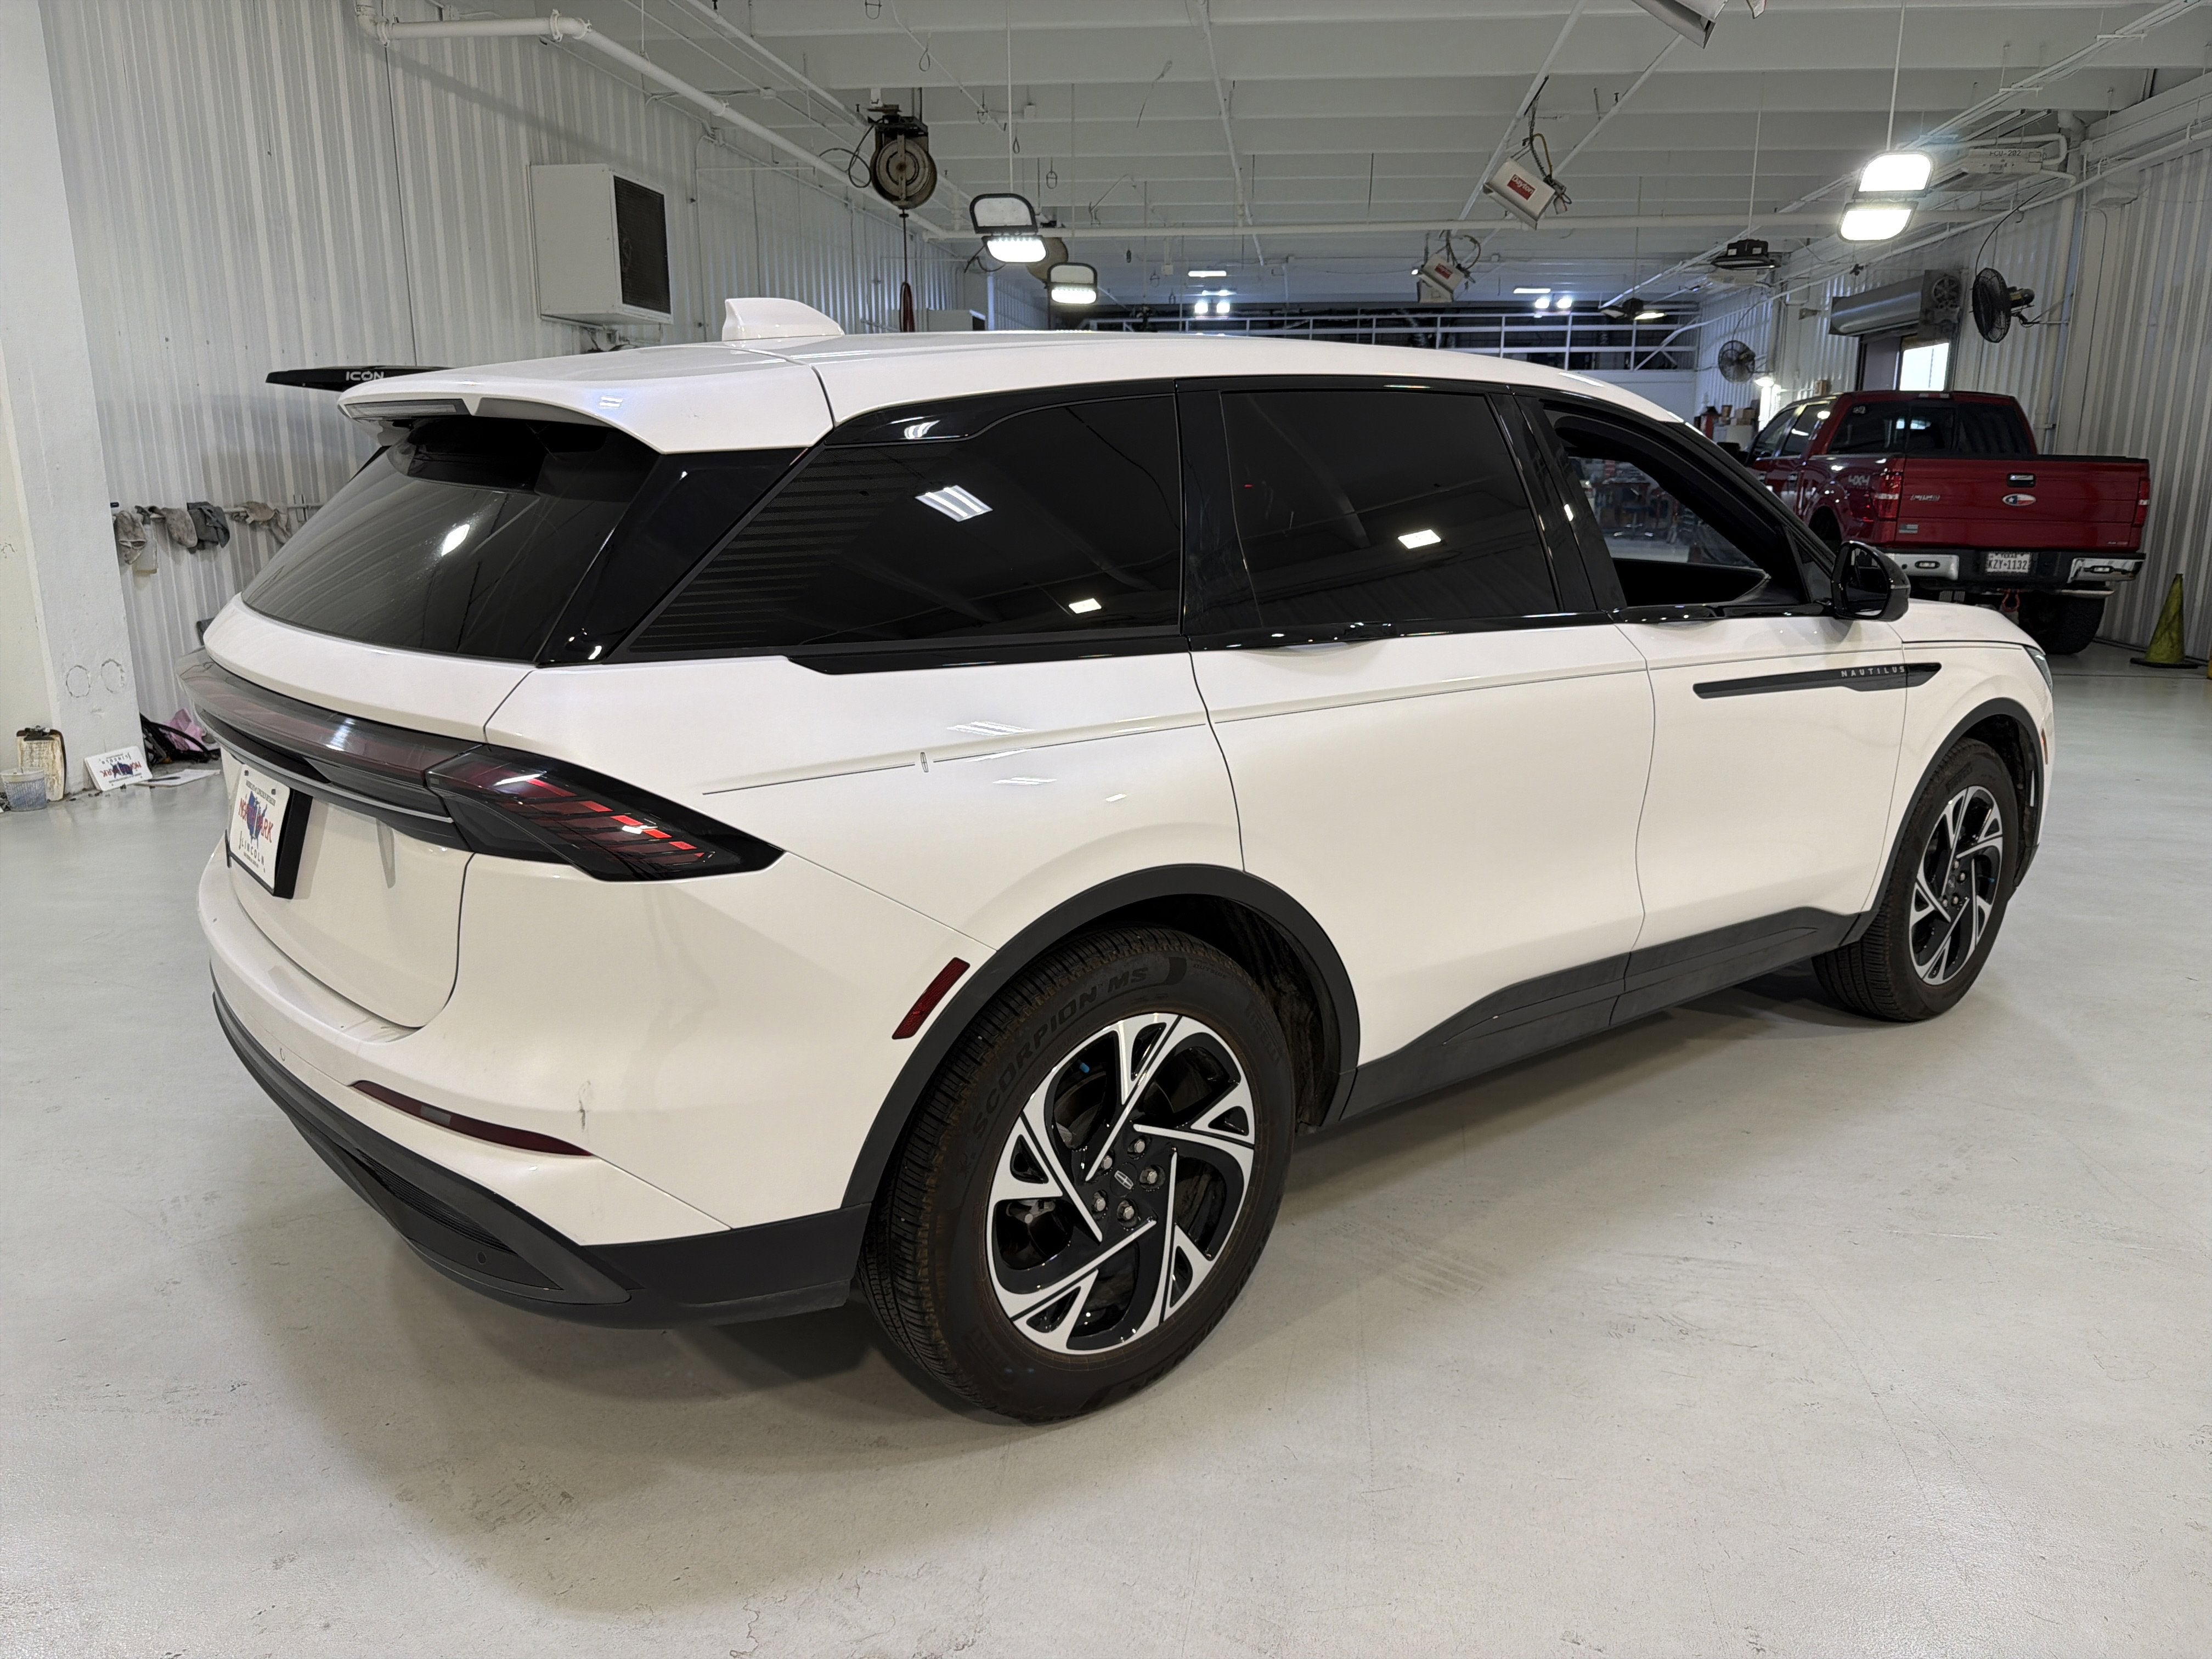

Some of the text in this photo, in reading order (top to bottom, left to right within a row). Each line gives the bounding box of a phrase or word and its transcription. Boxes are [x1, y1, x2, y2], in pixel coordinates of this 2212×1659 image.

[1511, 176, 1534, 194] Dayton
[346, 370, 384, 381] ICON
[1841, 665, 1905, 678] NAUTILUS
[241, 838, 264, 866] LINCOLN
[973, 967, 1148, 1139] SCORPION MS
